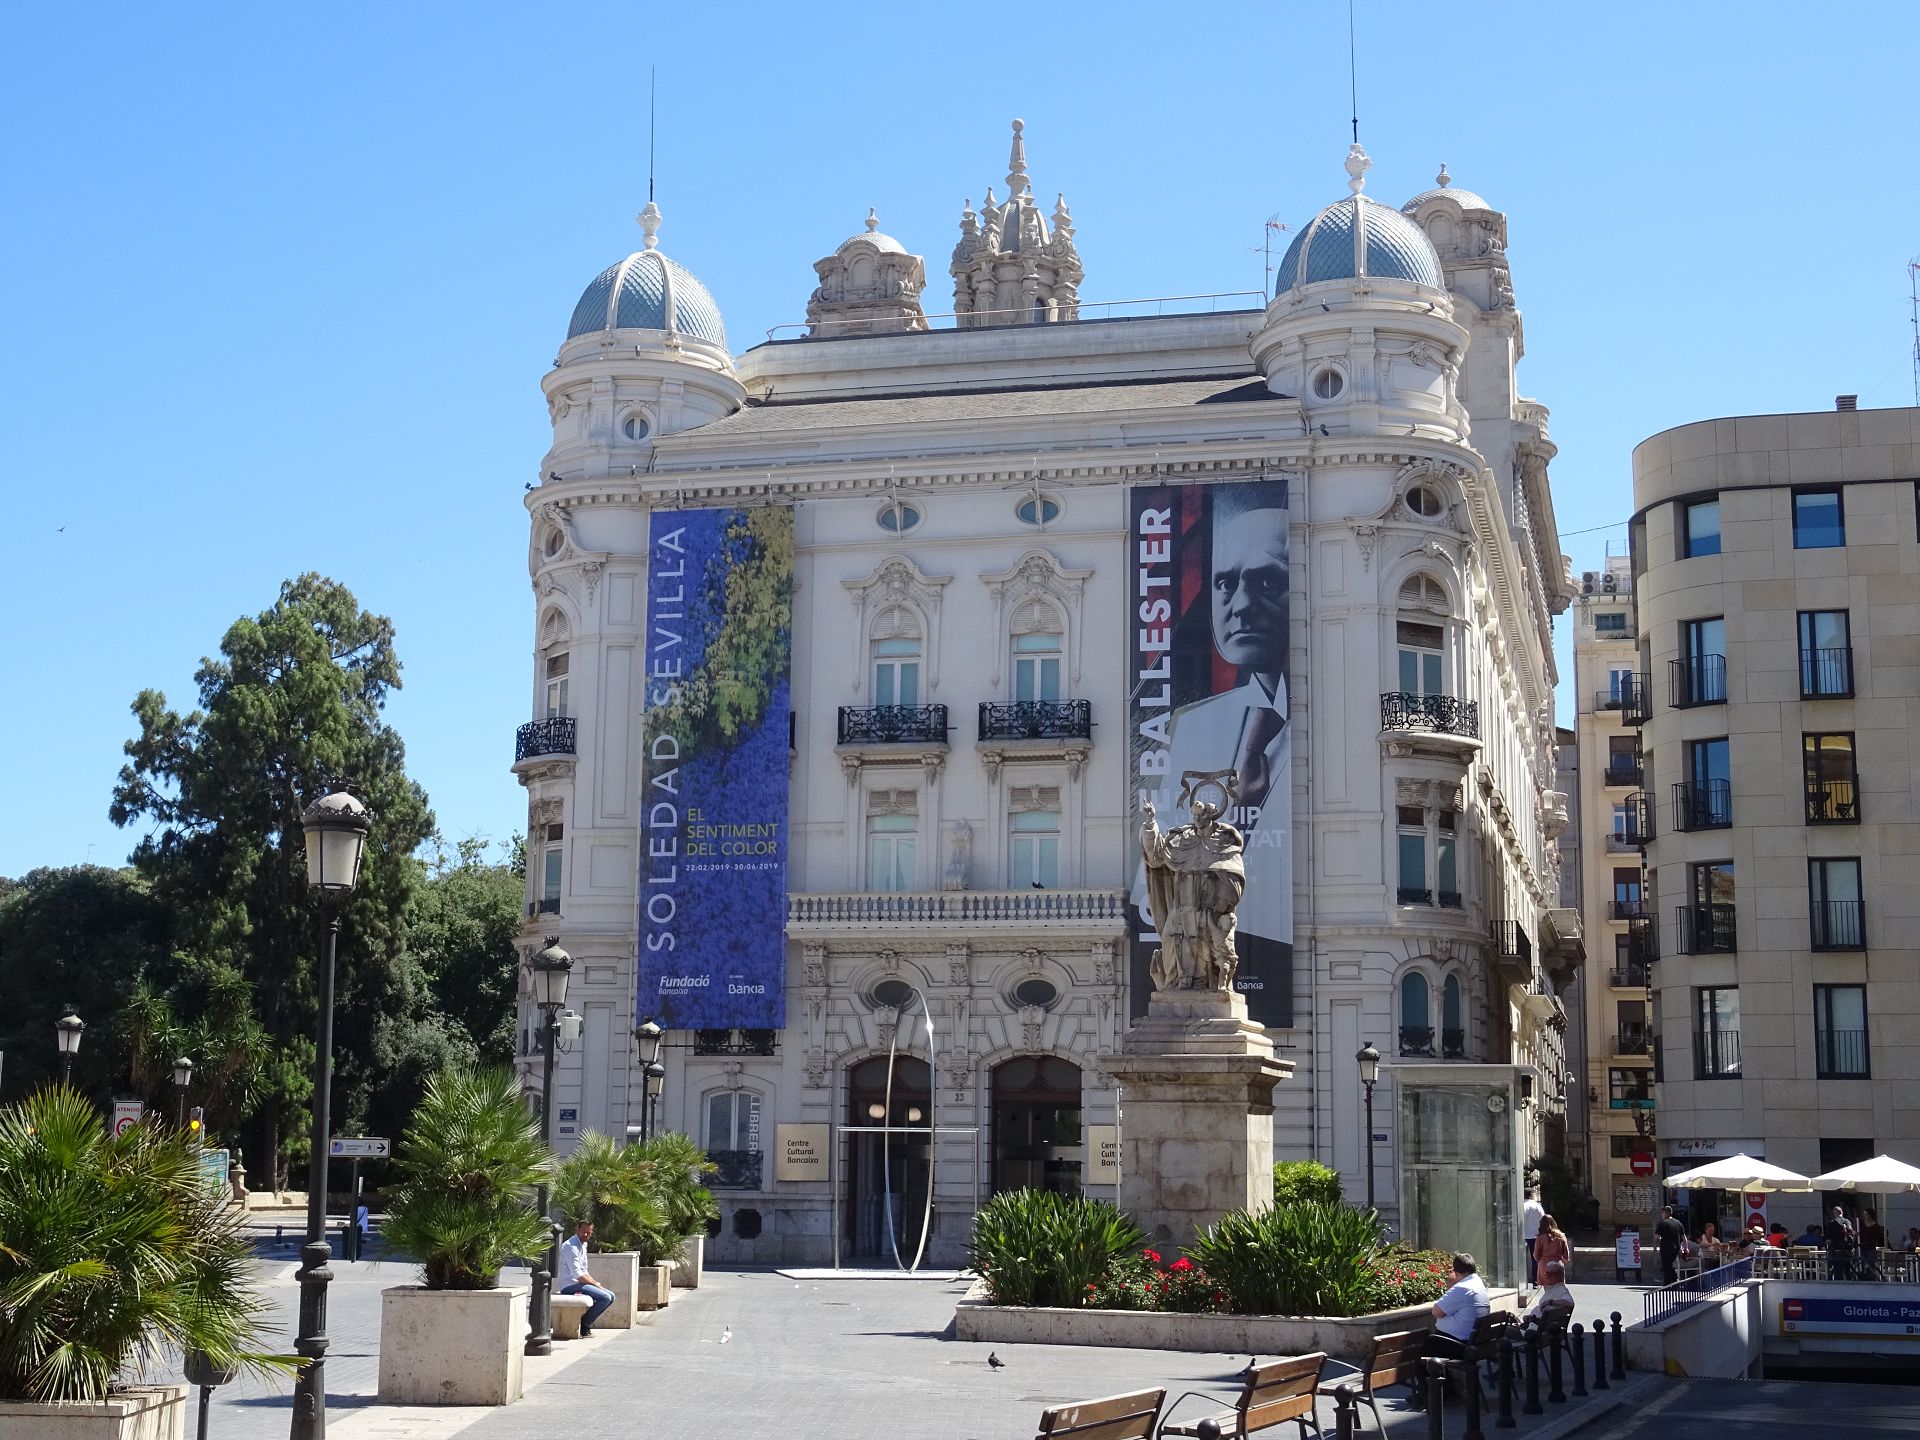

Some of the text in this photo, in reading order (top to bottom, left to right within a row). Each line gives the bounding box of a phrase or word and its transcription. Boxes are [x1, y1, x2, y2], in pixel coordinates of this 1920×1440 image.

[1139, 507, 1171, 776] BALLESTER
[646, 526, 687, 952] SOLEDAD SEVILLA
[688, 808, 705, 821] EL
[687, 823, 779, 838] SENTIMENT
[687, 841, 777, 856] DEL COLOR
[660, 974, 710, 987] Fundació
[1237, 981, 1264, 990] Bankia
[659, 987, 689, 995] Bancaixa
[728, 984, 765, 994] Bankia
[787, 1139, 810, 1147] Centre
[787, 1156, 819, 1164] Bancaixa
[1843, 1305, 1890, 1317] Glorieta
